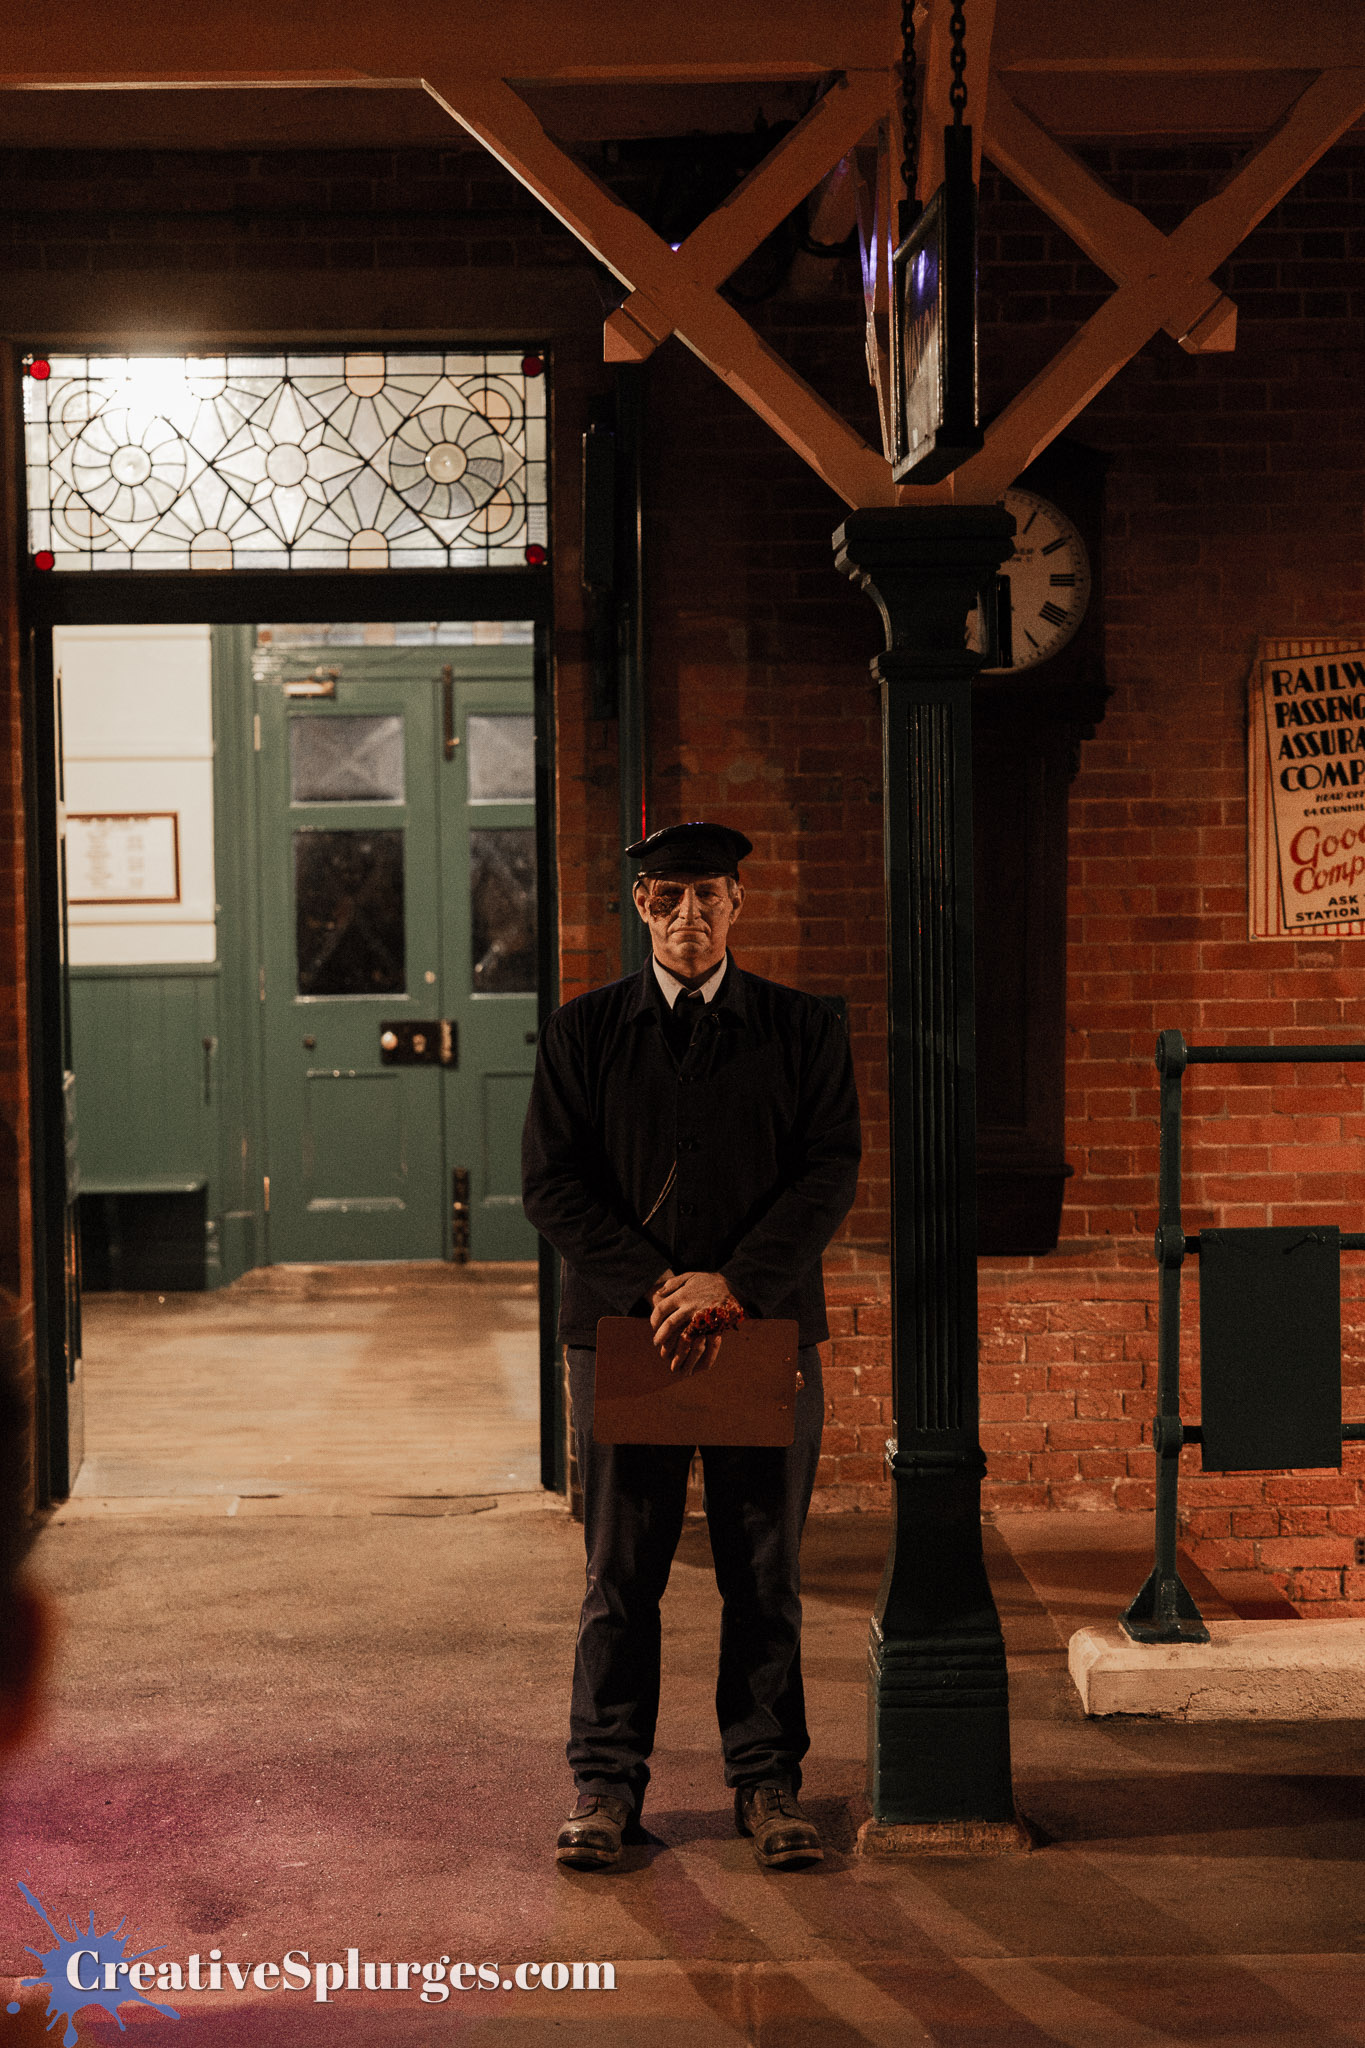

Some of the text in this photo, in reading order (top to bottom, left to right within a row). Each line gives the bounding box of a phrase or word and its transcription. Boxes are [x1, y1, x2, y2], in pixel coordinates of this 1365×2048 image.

[1272, 661, 1365, 696] RAILW
[1275, 693, 1365, 728] PASSENG
[1278, 726, 1365, 760] ASSURA
[1280, 759, 1365, 792] COMP
[1293, 855, 1365, 894] Comp
[1295, 907, 1359, 922] STATION
[1328, 895, 1358, 906] ASK
